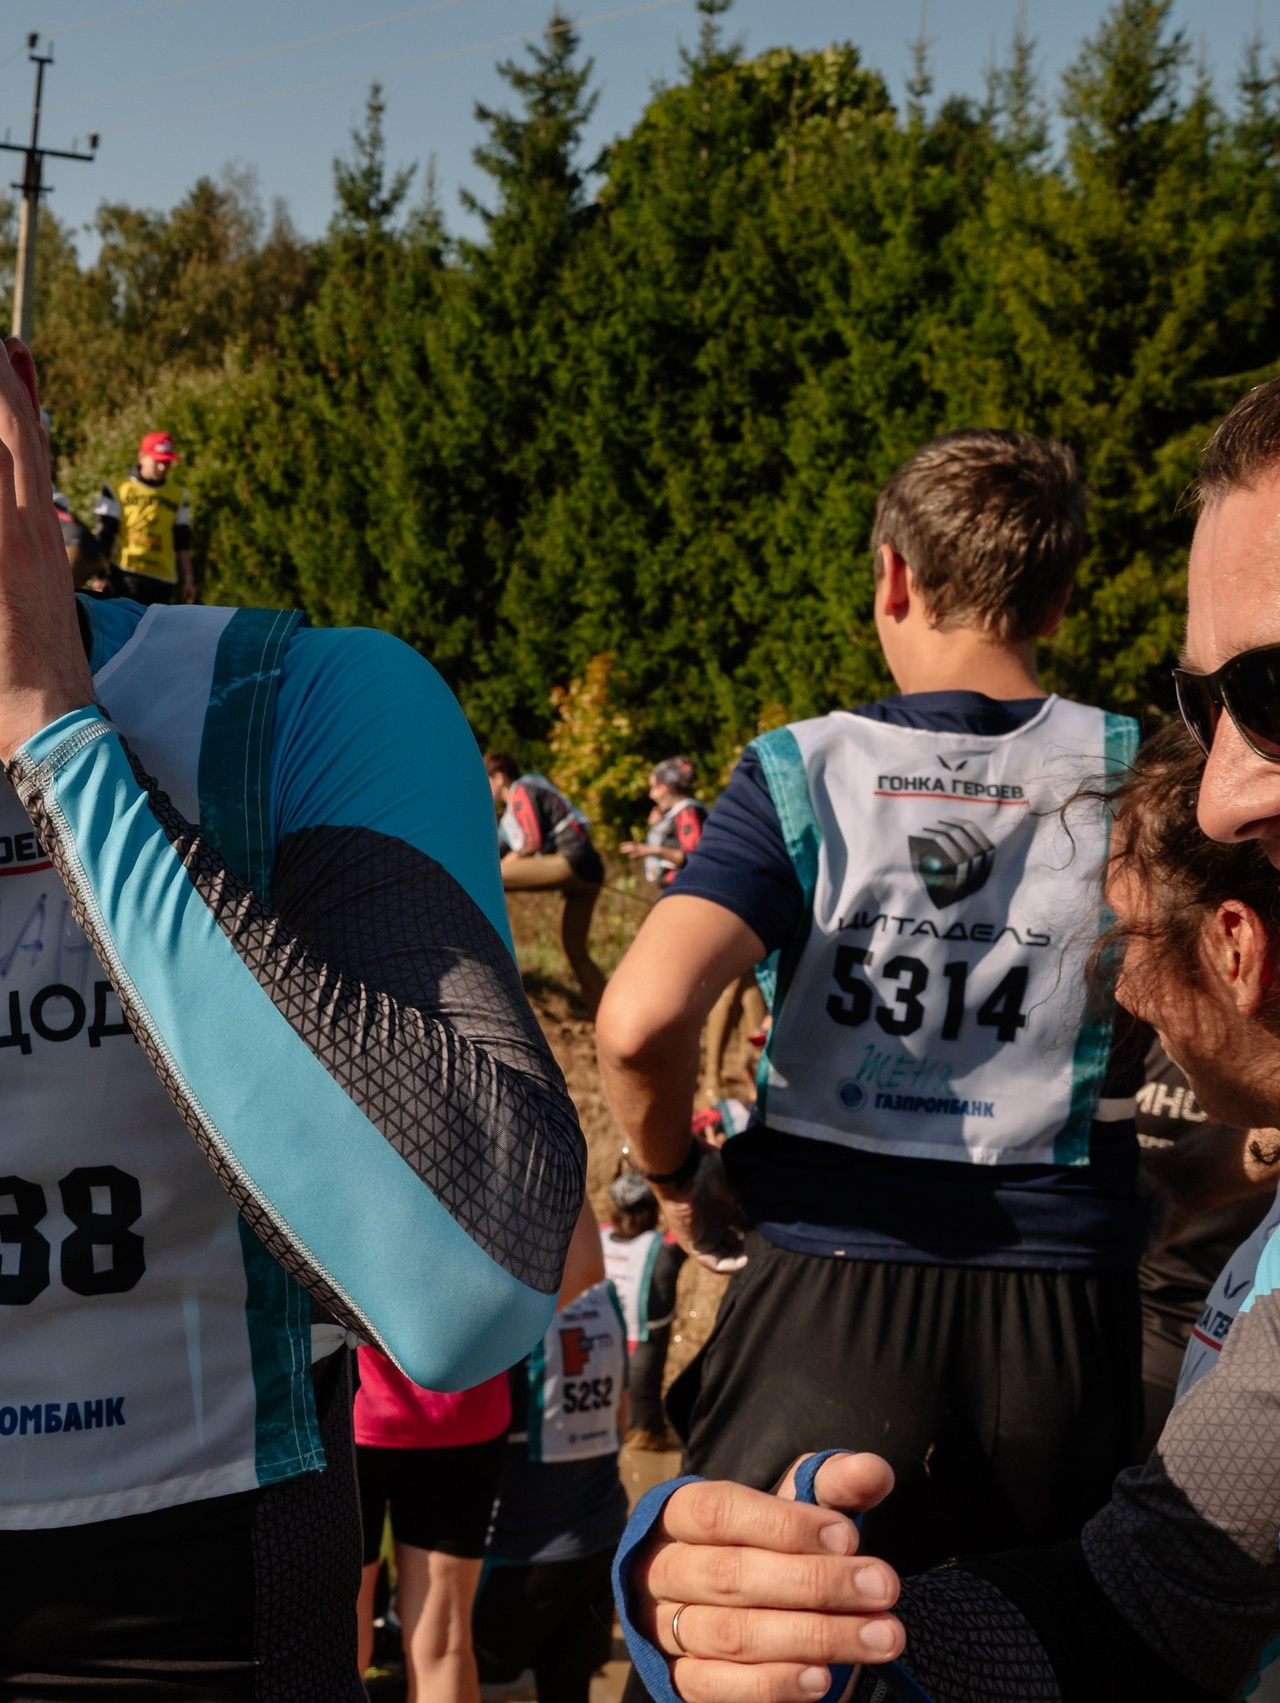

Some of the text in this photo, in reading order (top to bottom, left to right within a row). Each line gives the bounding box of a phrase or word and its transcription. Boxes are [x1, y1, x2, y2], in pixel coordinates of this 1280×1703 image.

[878, 775, 1024, 799] ГОНКА ГЕРОЕВ
[838, 911, 1051, 947] ЦИТАДЕЛЬ
[826, 945, 1029, 1043] 5314
[875, 1093, 995, 1118] ГАЗПРОМБАНК
[562, 1376, 614, 1414] 5252
